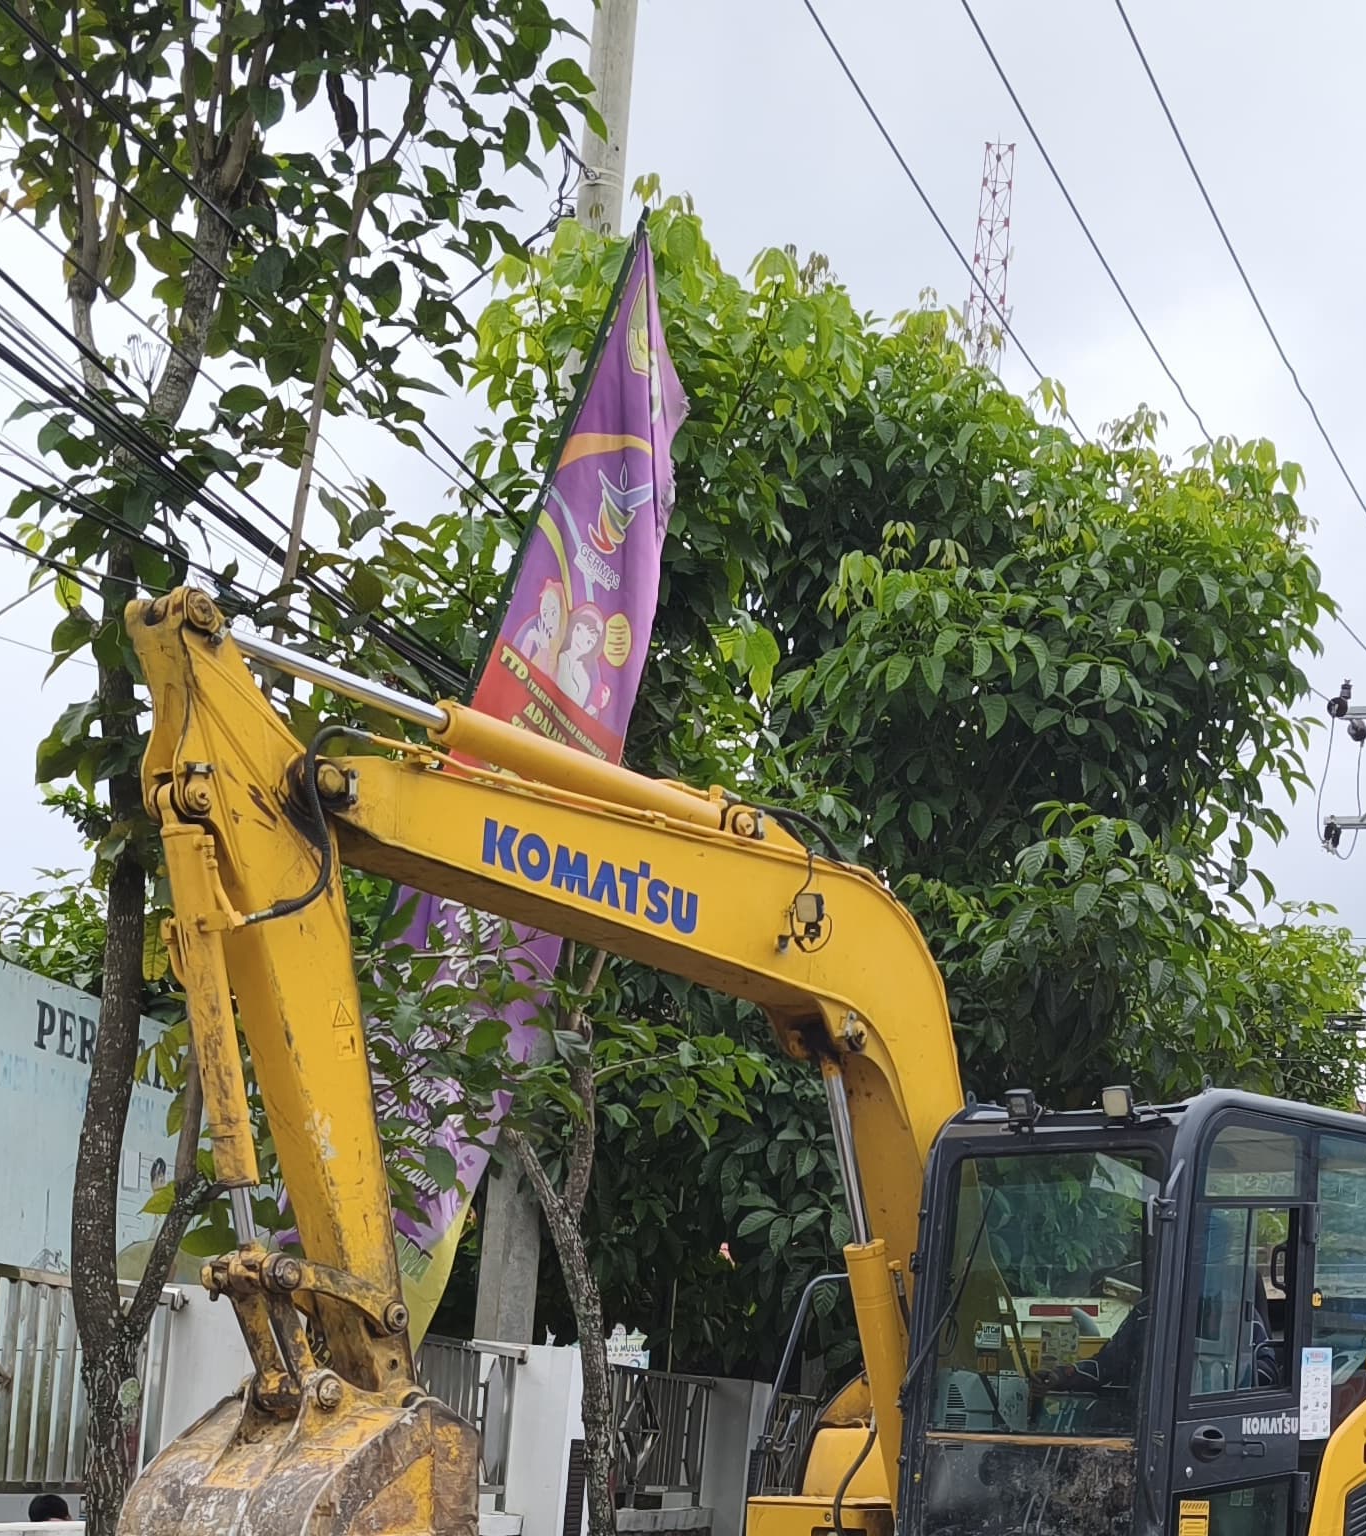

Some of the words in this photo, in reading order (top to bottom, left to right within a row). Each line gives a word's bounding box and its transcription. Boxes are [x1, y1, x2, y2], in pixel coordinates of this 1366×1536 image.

[500, 645, 529, 681] TTD
[481, 816, 699, 935] KOMATSU
[1241, 1411, 1299, 1436] KOMATSU
